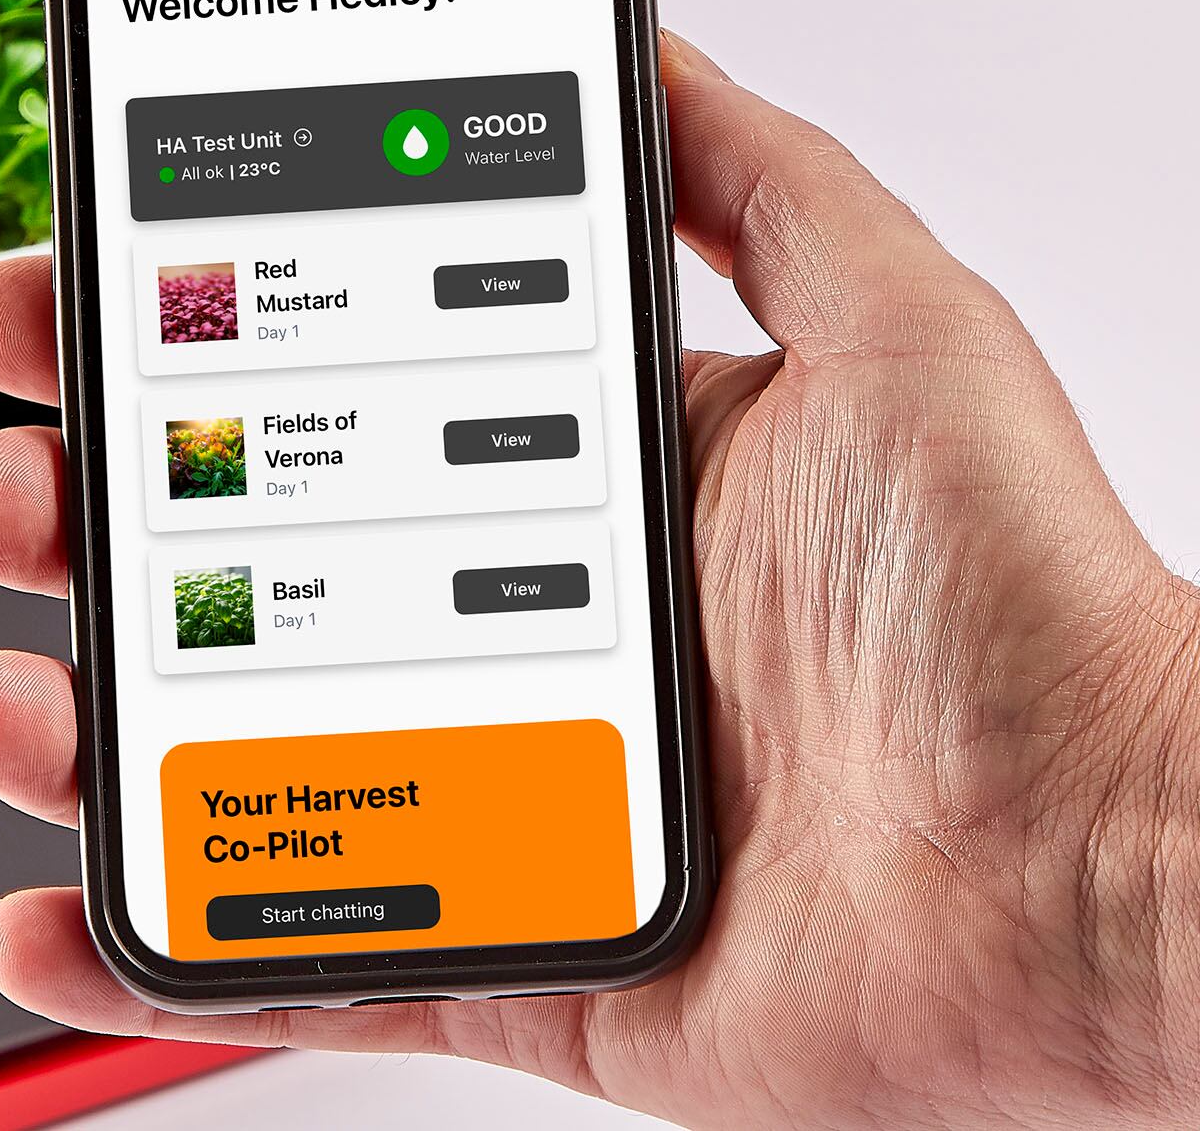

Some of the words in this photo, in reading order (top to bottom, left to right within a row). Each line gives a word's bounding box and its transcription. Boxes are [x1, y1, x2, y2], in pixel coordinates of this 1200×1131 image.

[463, 112, 547, 139] GOOD
[156, 137, 187, 155] HA
[191, 134, 236, 153] Test
[240, 130, 283, 150] Unit
[464, 151, 510, 165] Water
[515, 146, 555, 163] Level
[181, 166, 200, 181] All
[205, 164, 224, 180] ok
[254, 258, 297, 280] Red
[481, 277, 521, 292] View
[256, 288, 348, 314] Mustard
[257, 326, 287, 342] Day
[291, 324, 299, 338] 1
[263, 412, 329, 435] Fields
[334, 409, 358, 431] of
[491, 432, 532, 448] View
[264, 449, 344, 469] Verona
[266, 482, 296, 498] Day
[300, 480, 308, 494] 1
[272, 578, 326, 601] Basil
[500, 581, 541, 597] View
[274, 614, 304, 630] Day
[308, 612, 316, 626] 1
[200, 789, 278, 819] Your
[286, 780, 420, 814] Harvest
[203, 829, 344, 864] Co-Pilot
[262, 906, 306, 924] Start
[311, 901, 385, 921] chatting
